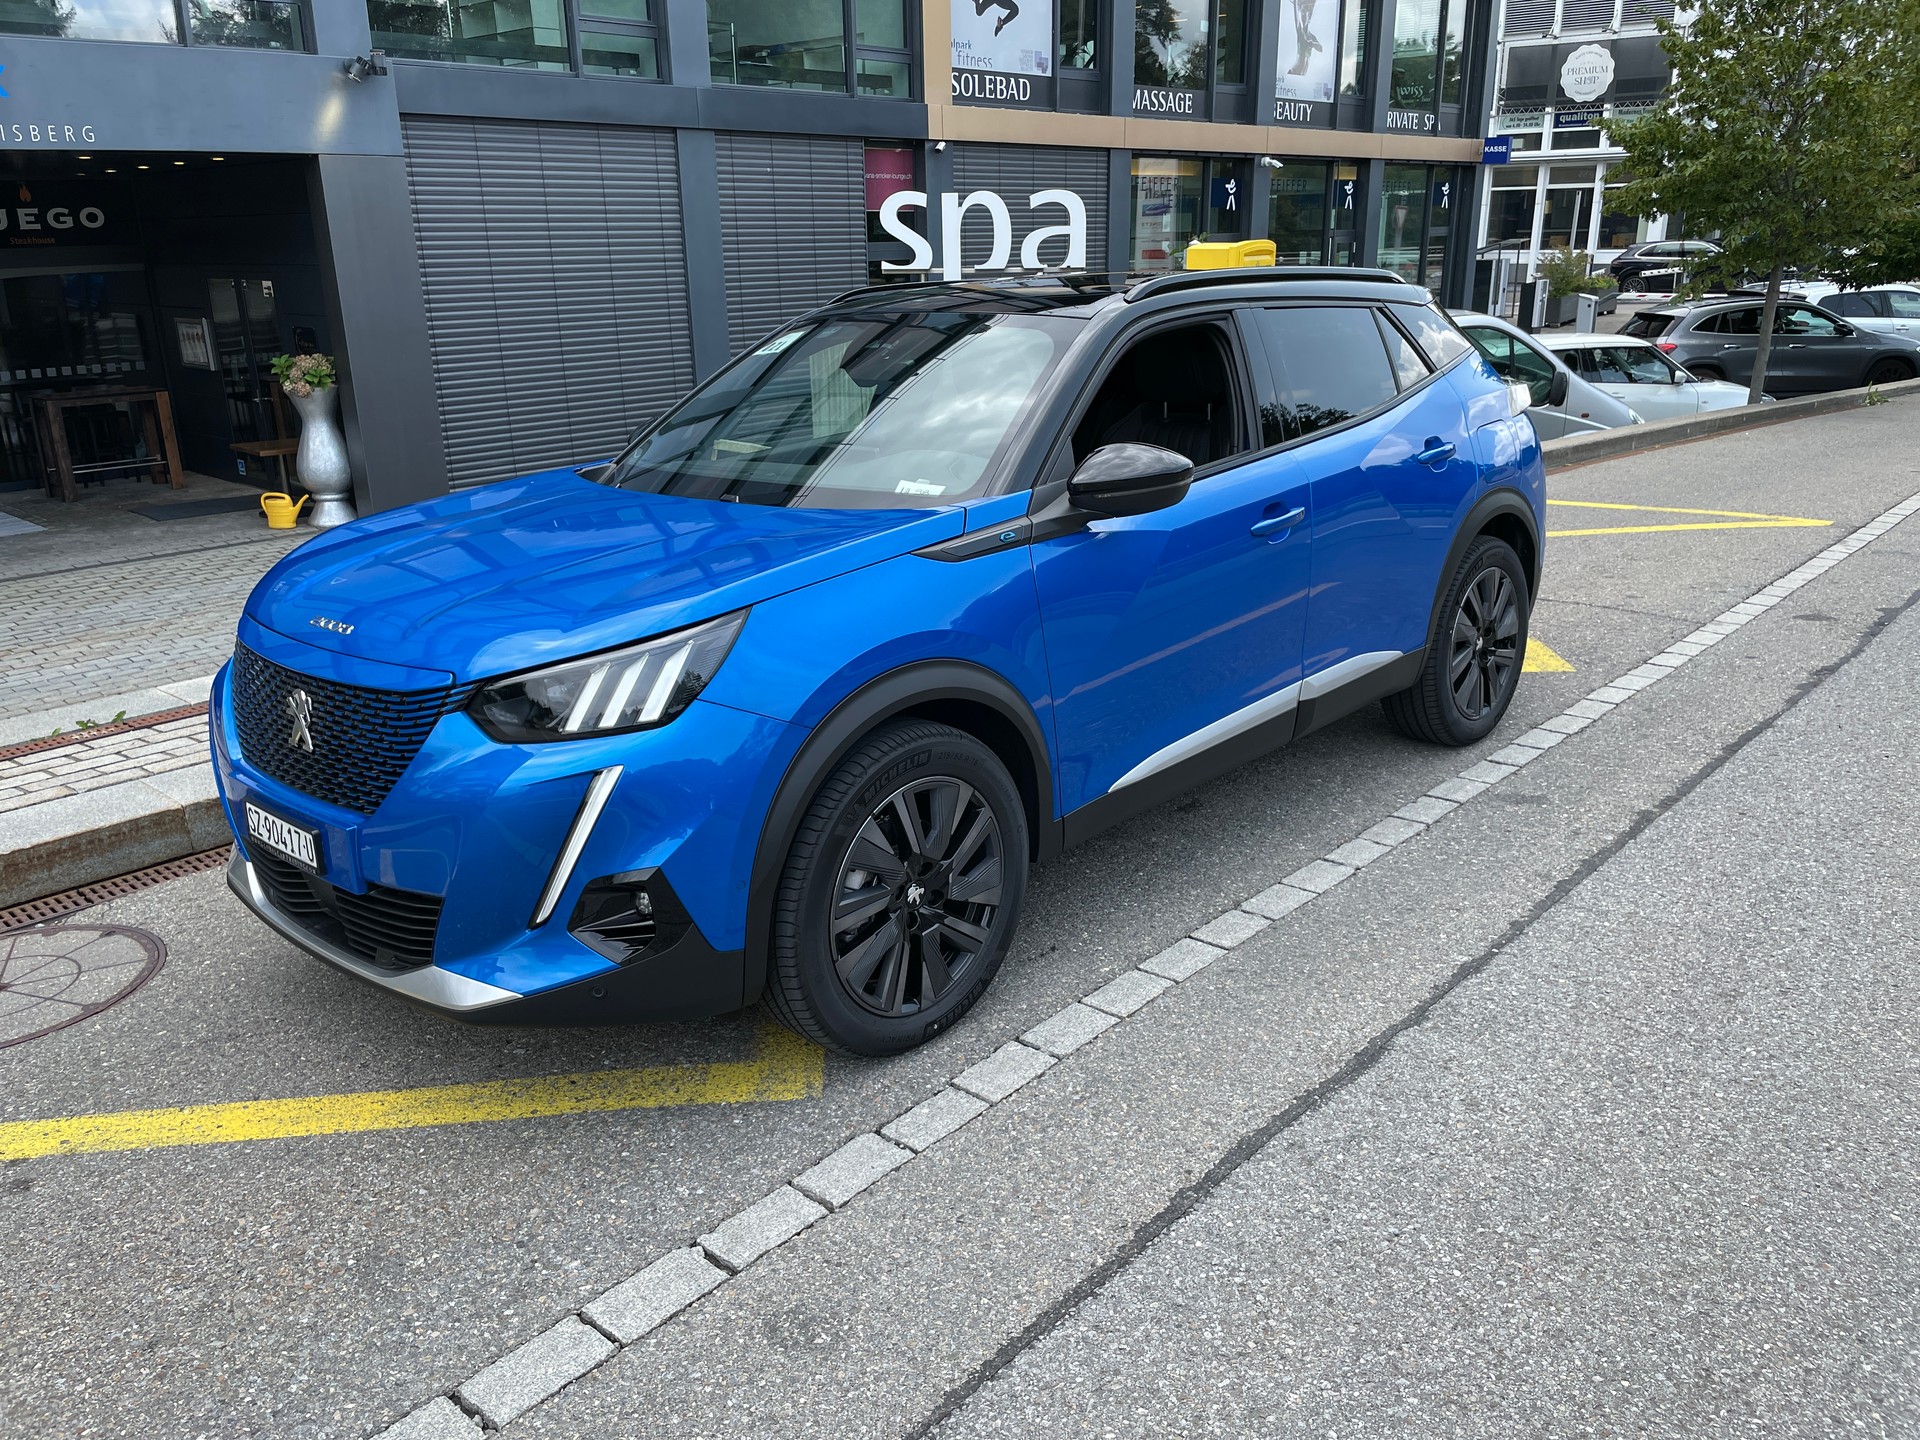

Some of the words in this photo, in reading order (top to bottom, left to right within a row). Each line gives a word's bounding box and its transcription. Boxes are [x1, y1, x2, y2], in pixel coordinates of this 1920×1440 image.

[957, 50, 993, 68] fitness
[1566, 65, 1609, 76] PREMIUM
[951, 72, 1031, 101] SOLEBAD
[1573, 75, 1600, 86] SHOP
[1273, 101, 1313, 122] EAUTY
[1559, 111, 1600, 123] qualiton
[1484, 145, 1507, 153] KASSE
[1131, 176, 1179, 192] FEIFFER
[9, 236, 57, 246] Steakhouse
[879, 189, 1087, 281] spa
[309, 615, 355, 635] 2008
[863, 751, 931, 803] MICHELIN
